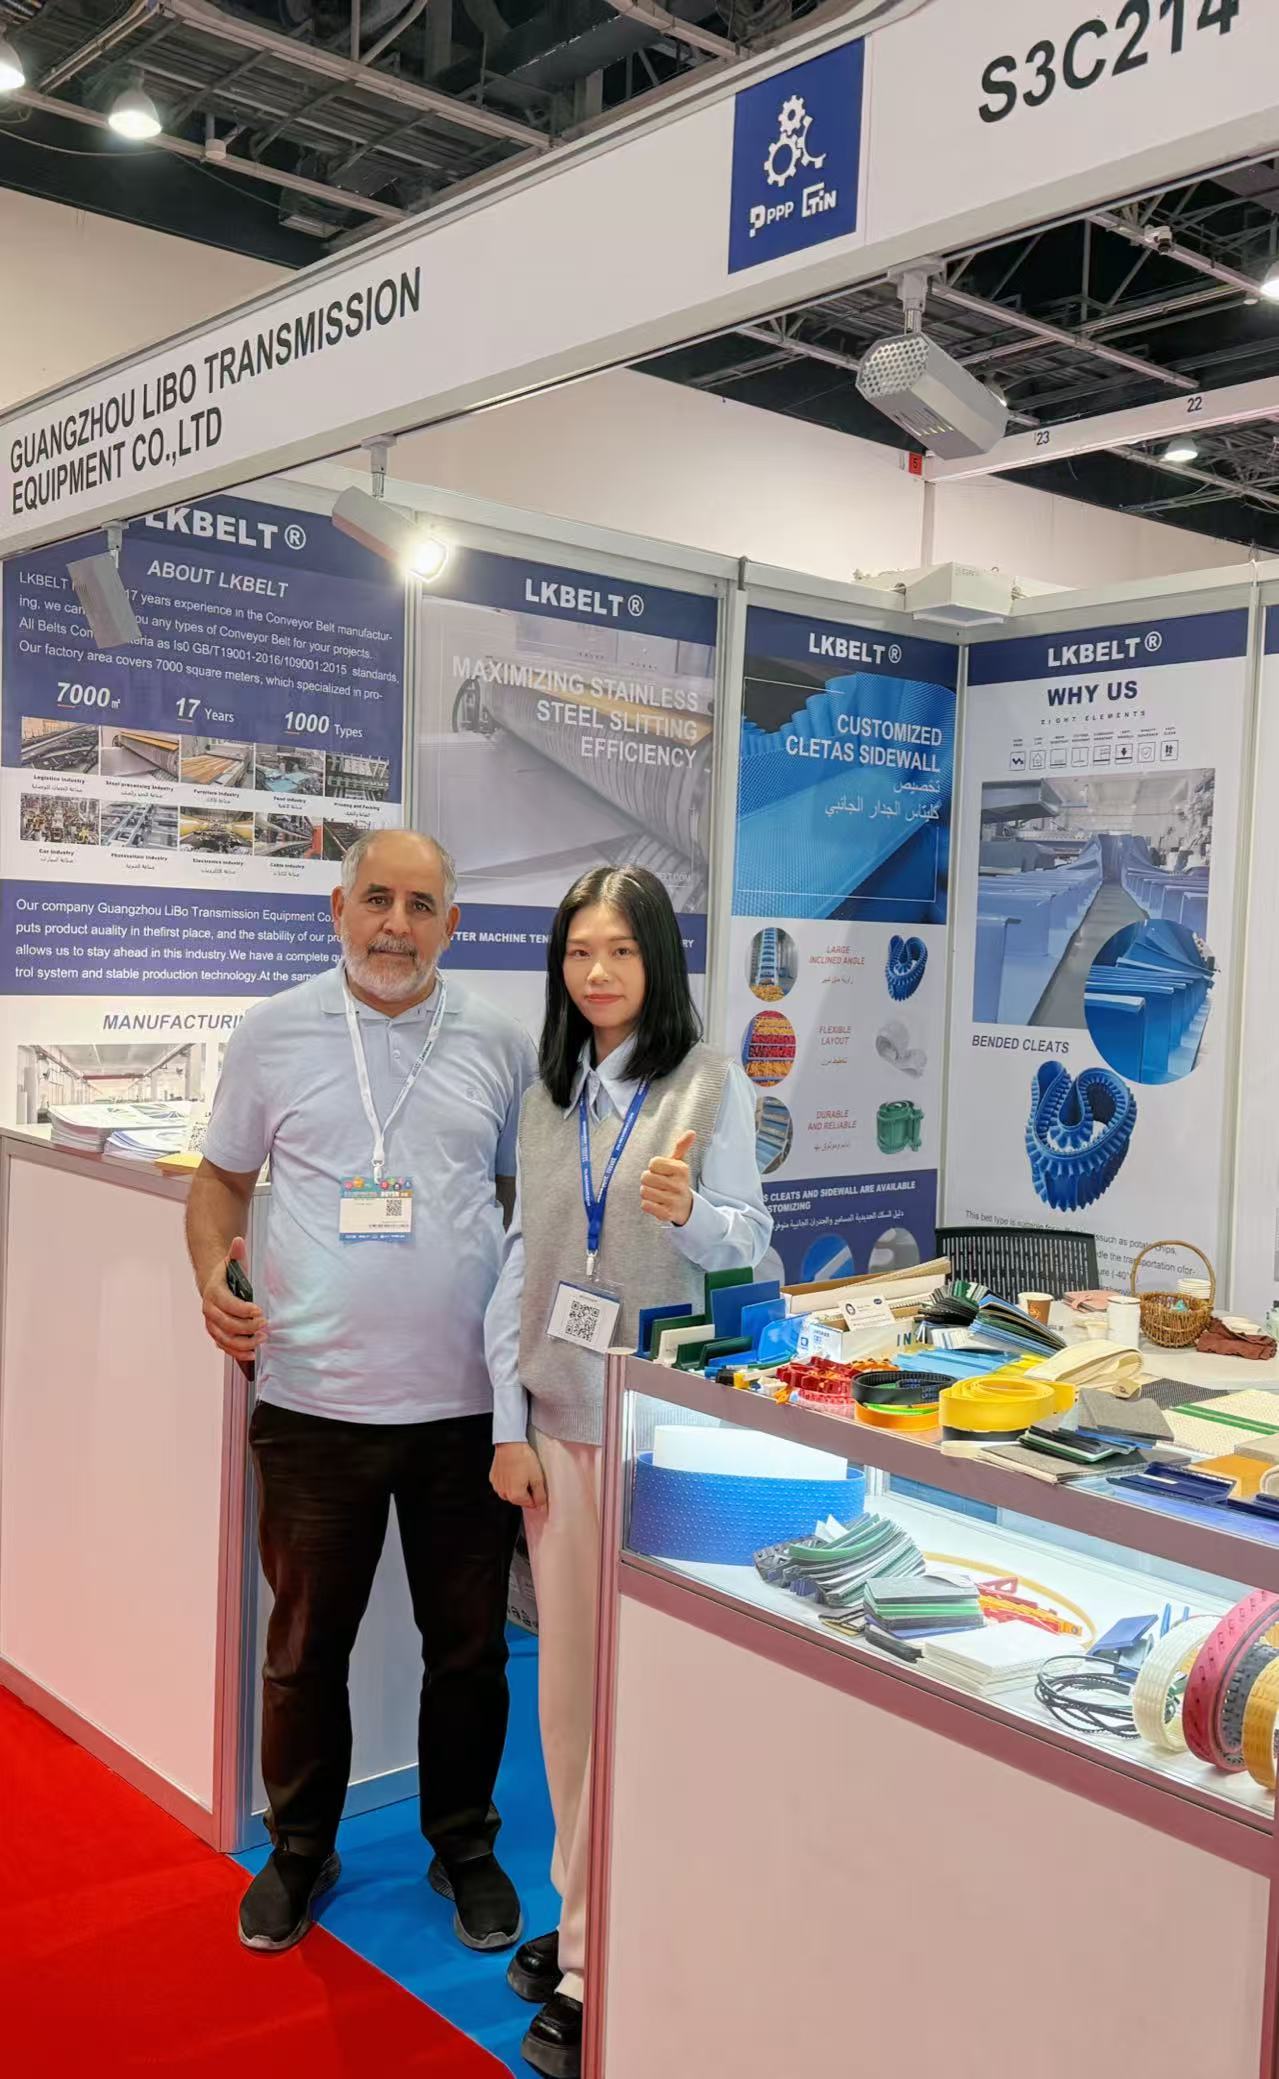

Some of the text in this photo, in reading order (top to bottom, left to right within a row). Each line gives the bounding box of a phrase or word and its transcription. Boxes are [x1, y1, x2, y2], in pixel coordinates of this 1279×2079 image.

[978, 0, 1240, 123] S3C214
[11, 267, 420, 473] GUANGZHOU LIBO TRANSMISSION
[1187, 396, 1202, 413] 22
[1036, 430, 1050, 446] 23
[13, 406, 222, 515] EQUIPMENT CO.,LTD
[145, 508, 277, 550] LKBELT
[147, 560, 288, 598] ABOUT LKBELT
[19, 572, 68, 589] LKBELT
[140, 592, 171, 607] years
[174, 598, 232, 616] experience
[235, 608, 244, 618] in
[247, 610, 263, 622] the
[266, 612, 313, 630] Conveyor
[316, 620, 335, 633] Belt
[337, 625, 393, 641] manufactur-
[525, 578, 623, 617] LKBELT
[19, 617, 34, 630] All
[38, 620, 66, 634] Belts
[157, 639, 170, 650] as
[44, 601, 61, 612] we
[134, 615, 148, 625] ou
[152, 617, 172, 630] any
[174, 619, 203, 634] types
[206, 624, 217, 635] of
[220, 625, 268, 644] Conveyor
[272, 634, 290, 646] Belt
[293, 638, 306, 649] for
[309, 643, 330, 654] your
[809, 633, 885, 665] LKBELT
[1047, 637, 1140, 668] LKBELT
[19, 640, 41, 654] Our
[45, 645, 83, 662] factory
[87, 652, 112, 665] area
[116, 655, 152, 670] covers
[156, 659, 183, 673] 7000
[186, 663, 221, 679] square
[266, 675, 294, 688] which
[297, 679, 350, 697] specialized
[353, 687, 361, 698] in
[452, 655, 699, 713] MAXIMIZING STAINLESS
[57, 681, 110, 708] 7000
[1047, 680, 1138, 707] WHY US
[176, 697, 234, 723] 17 Years
[284, 711, 363, 740] 1000 Types
[536, 699, 697, 741] STEEL SLITTING
[837, 714, 942, 746] CUSTOMIZED
[581, 736, 697, 769] EFFICIENCY
[786, 735, 940, 774] CLETAS SIDEWALL
[16, 898, 39, 912] Our
[42, 901, 94, 916] company
[98, 902, 161, 917] Guangzhou
[165, 904, 189, 917] LiBo
[192, 906, 260, 920] Transmission
[263, 909, 315, 923] Equipment
[16, 922, 41, 936] puts
[45, 923, 88, 937] product
[131, 925, 140, 937] in
[182, 927, 214, 940] place,
[217, 928, 237, 940] and
[239, 929, 255, 941] the
[257, 930, 295, 944] stability
[298, 931, 308, 941] of
[309, 933, 324, 943] our
[479, 932, 527, 944] MACHINE
[16, 944, 52, 957] allows
[56, 946, 69, 957] us
[73, 946, 83, 957] to
[87, 947, 110, 960] stay
[113, 947, 147, 959] ahead
[151, 947, 160, 958] in
[163, 947, 182, 959] this
[250, 949, 274, 961] have
[277, 951, 283, 961] a
[285, 951, 329, 964] complete
[15, 966, 33, 978] trol
[37, 968, 78, 981] system
[82, 967, 102, 979] and
[106, 968, 139, 980] stable
[142, 969, 198, 982] production
[273, 971, 288, 982] the
[972, 1035, 1070, 1054] BENDED CLEATS
[767, 1201, 811, 1213] STOMIZING
[770, 1190, 801, 1202] CLEATS
[802, 1189, 819, 1199] AND
[820, 1186, 858, 1198] SIDEWALL
[860, 1184, 875, 1194] ARE
[876, 1180, 916, 1192] AVAILABLE
